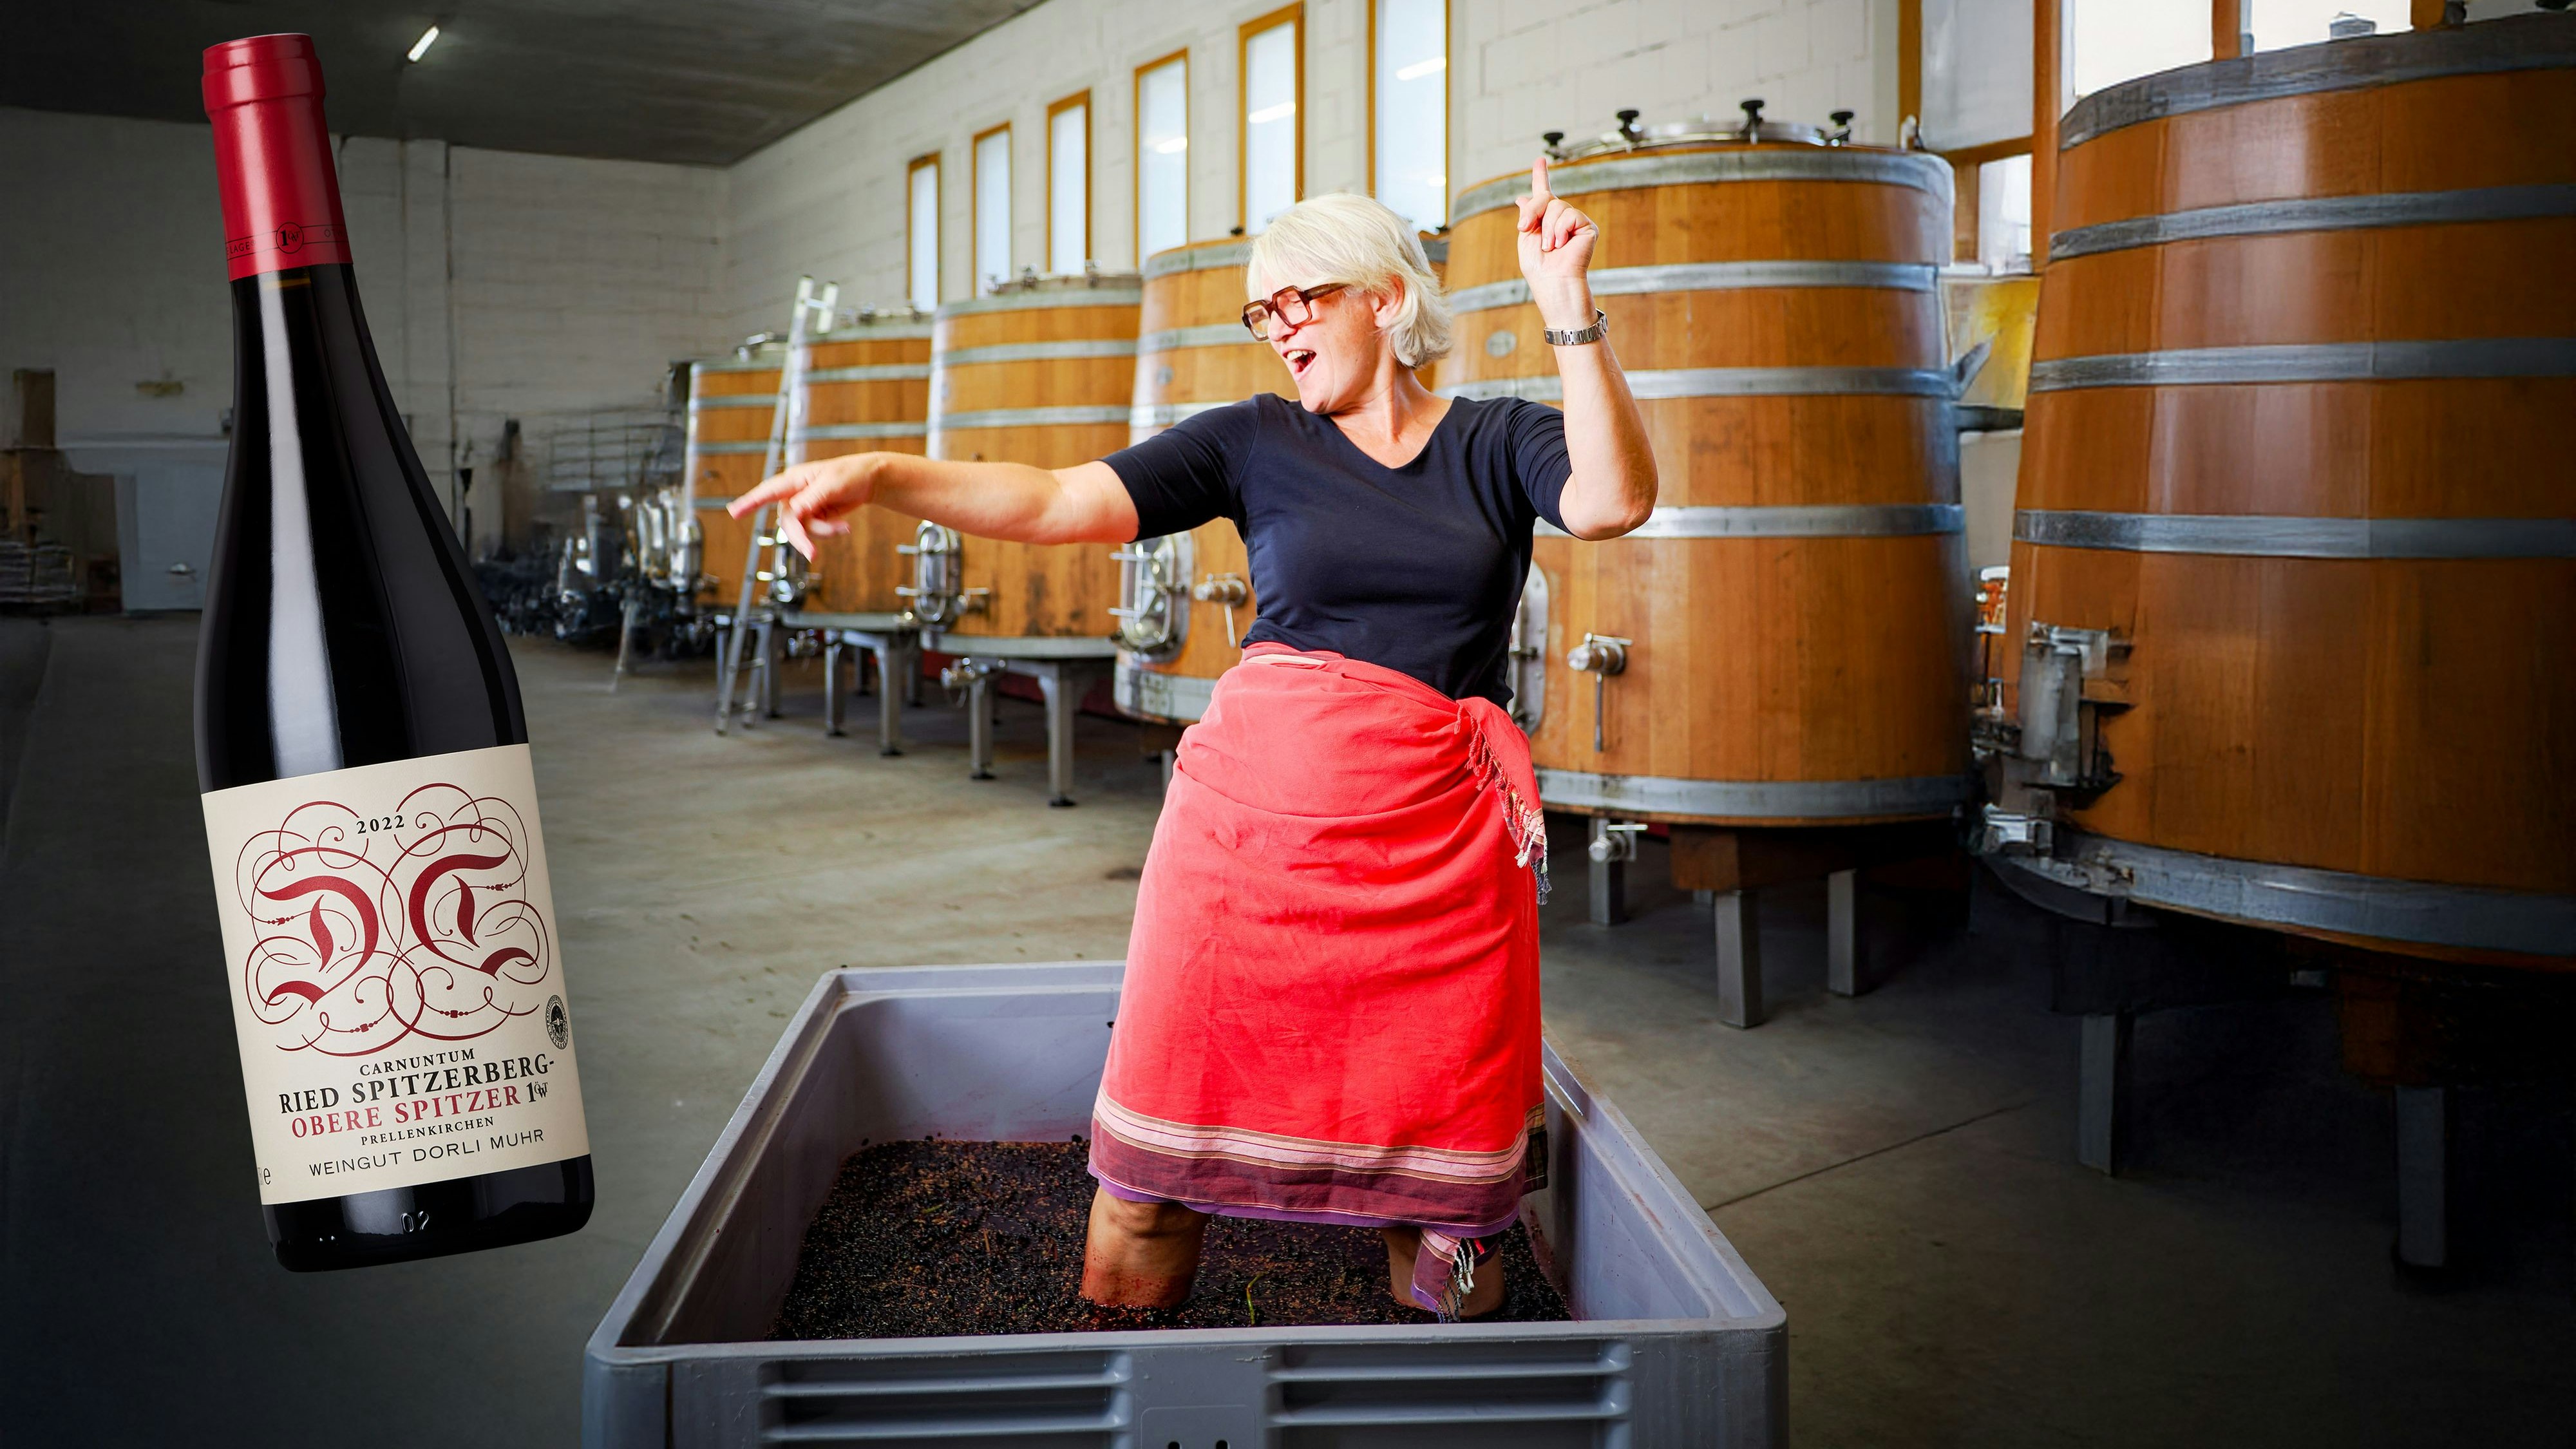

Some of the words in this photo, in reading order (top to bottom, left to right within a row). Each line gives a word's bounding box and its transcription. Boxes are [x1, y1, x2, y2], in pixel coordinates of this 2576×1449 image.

[356, 815, 405, 835] 2022
[359, 1048, 475, 1076] CARNUNTUM
[278, 1086, 339, 1115] RIED
[352, 1053, 554, 1103] SPITZERBERG-
[292, 1107, 383, 1138] OBERE
[395, 1084, 522, 1123] SPITZER
[361, 1116, 494, 1146] PRELLENKIRCHEN
[309, 1151, 402, 1177] WEINGUT
[413, 1139, 480, 1162] DORLI
[490, 1128, 544, 1150] MUHR
